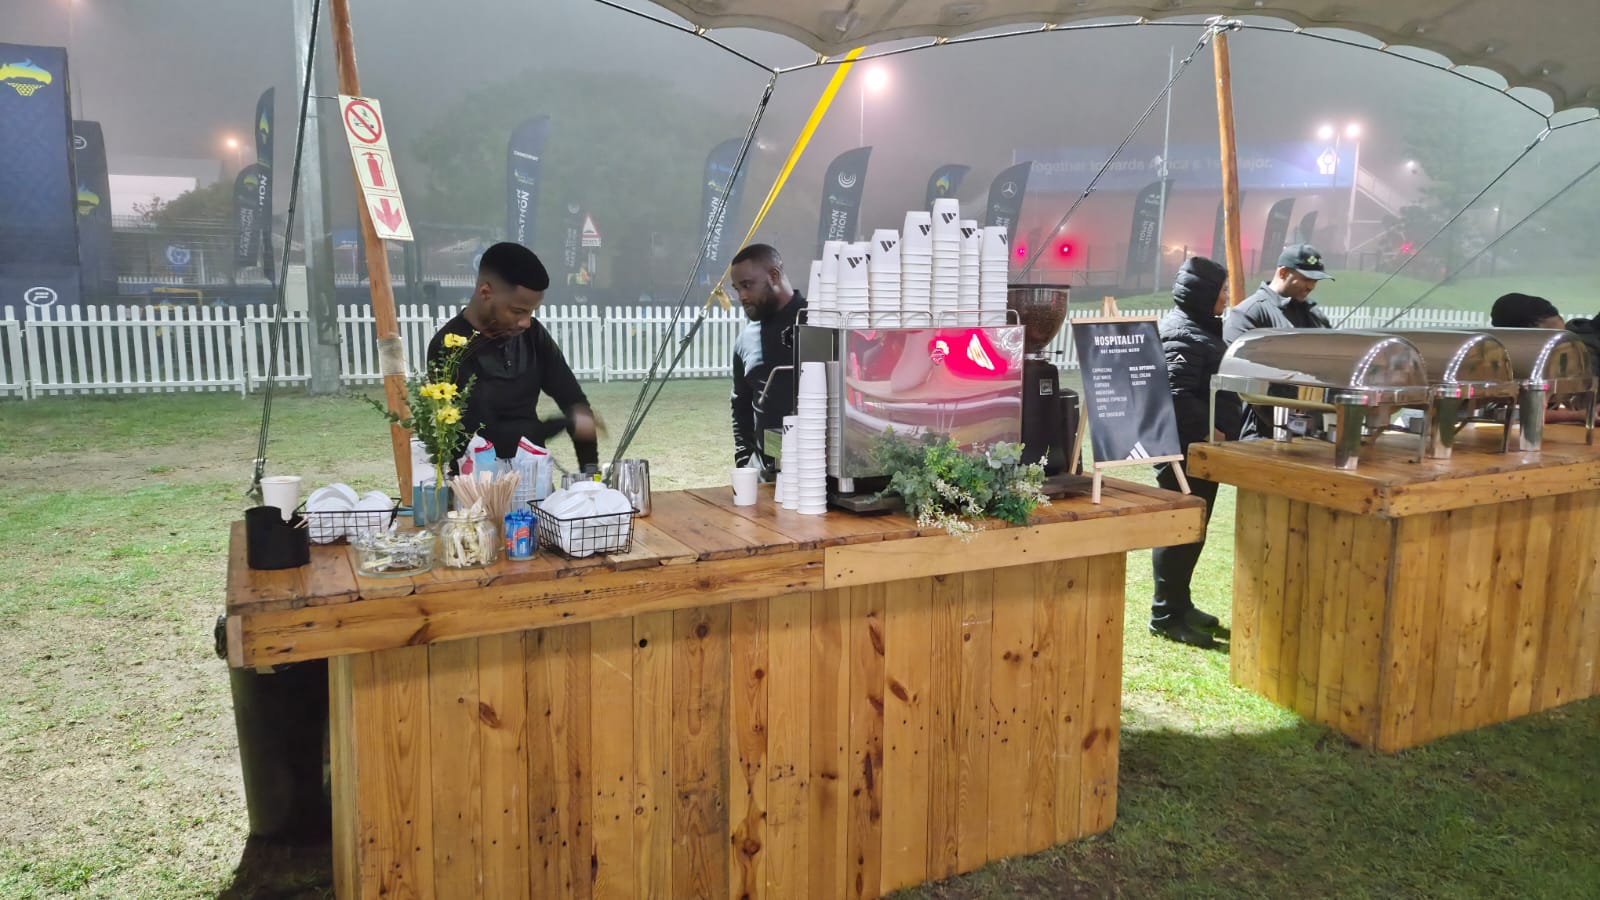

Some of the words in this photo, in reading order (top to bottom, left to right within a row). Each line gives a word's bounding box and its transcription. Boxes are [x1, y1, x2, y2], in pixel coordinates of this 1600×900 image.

[1031, 160, 1084, 176] Together
[1090, 160, 1145, 172] towards
[706, 196, 719, 230] TOWN
[828, 208, 840, 240] TOWN
[1094, 334, 1145, 346] HOSPITALITY
